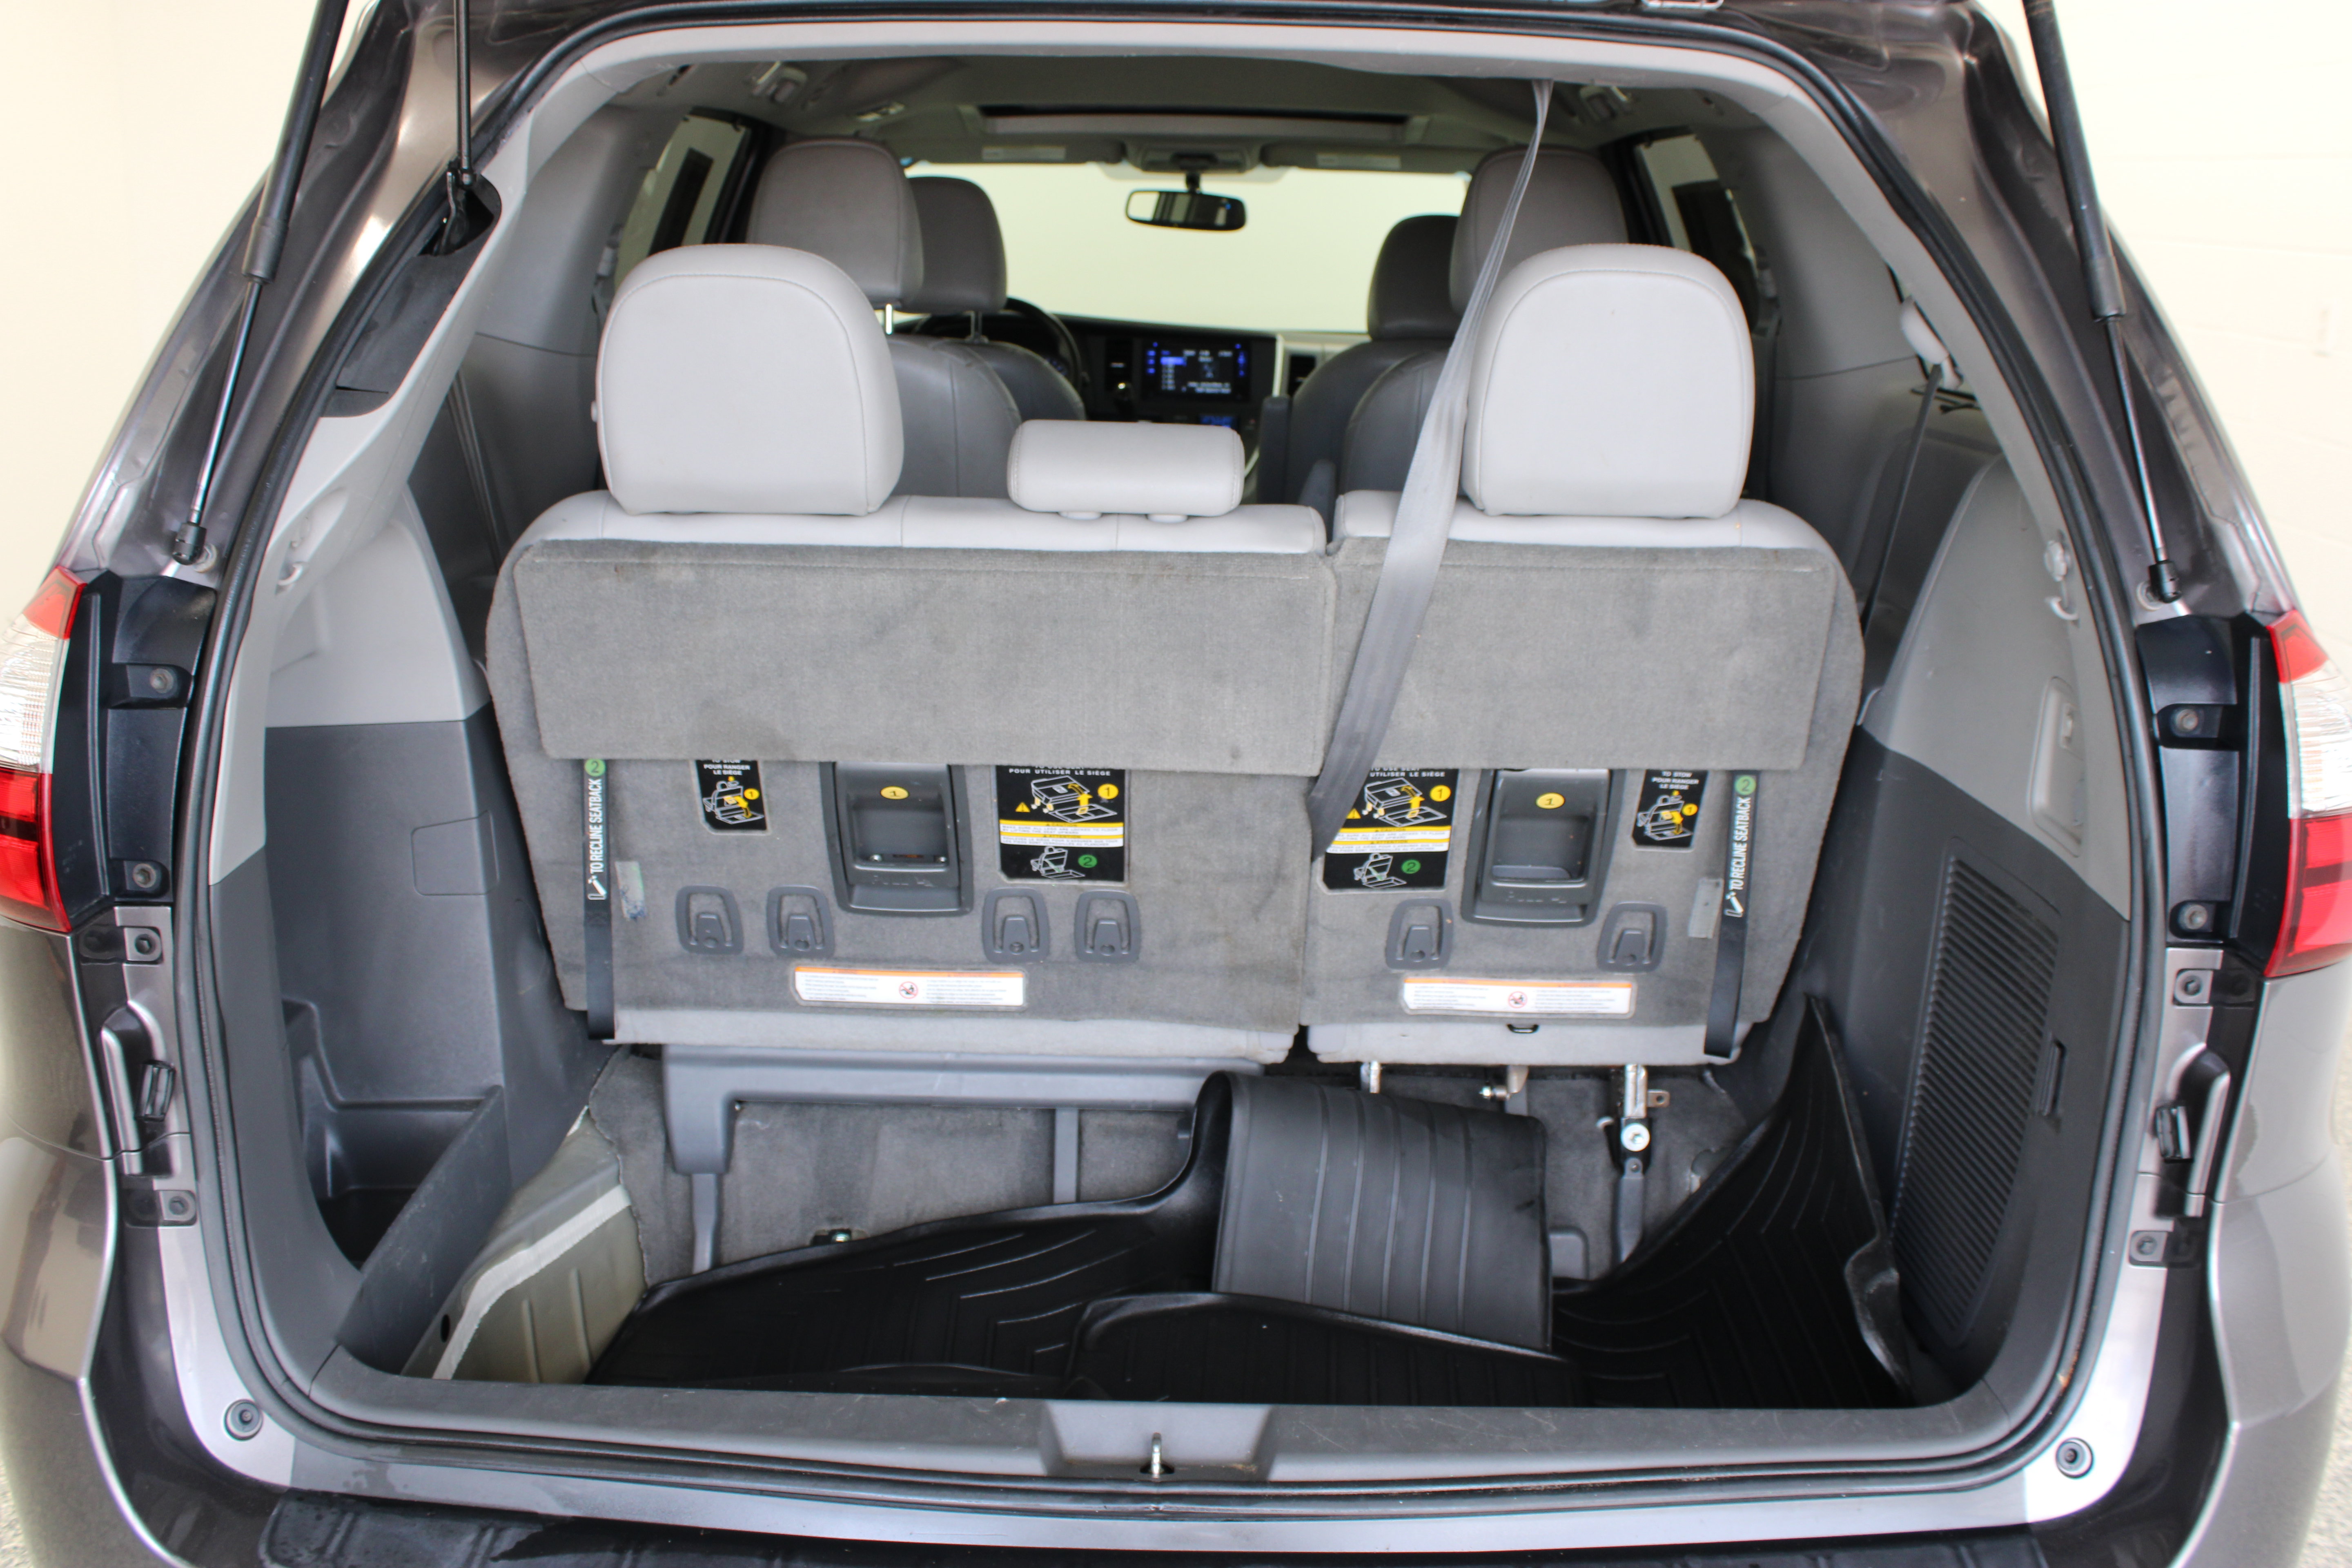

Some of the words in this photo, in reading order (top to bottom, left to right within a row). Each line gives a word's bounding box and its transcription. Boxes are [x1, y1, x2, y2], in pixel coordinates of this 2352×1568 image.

[591, 761, 599, 773] 2
[1742, 779, 1751, 792] 2
[588, 778, 603, 823] SEATBACK
[1733, 796, 1751, 842] SEATBACK
[588, 824, 604, 862] RECLINE
[589, 862, 604, 875] TO
[1729, 842, 1748, 878] RECLINE
[1728, 878, 1744, 890] TO
